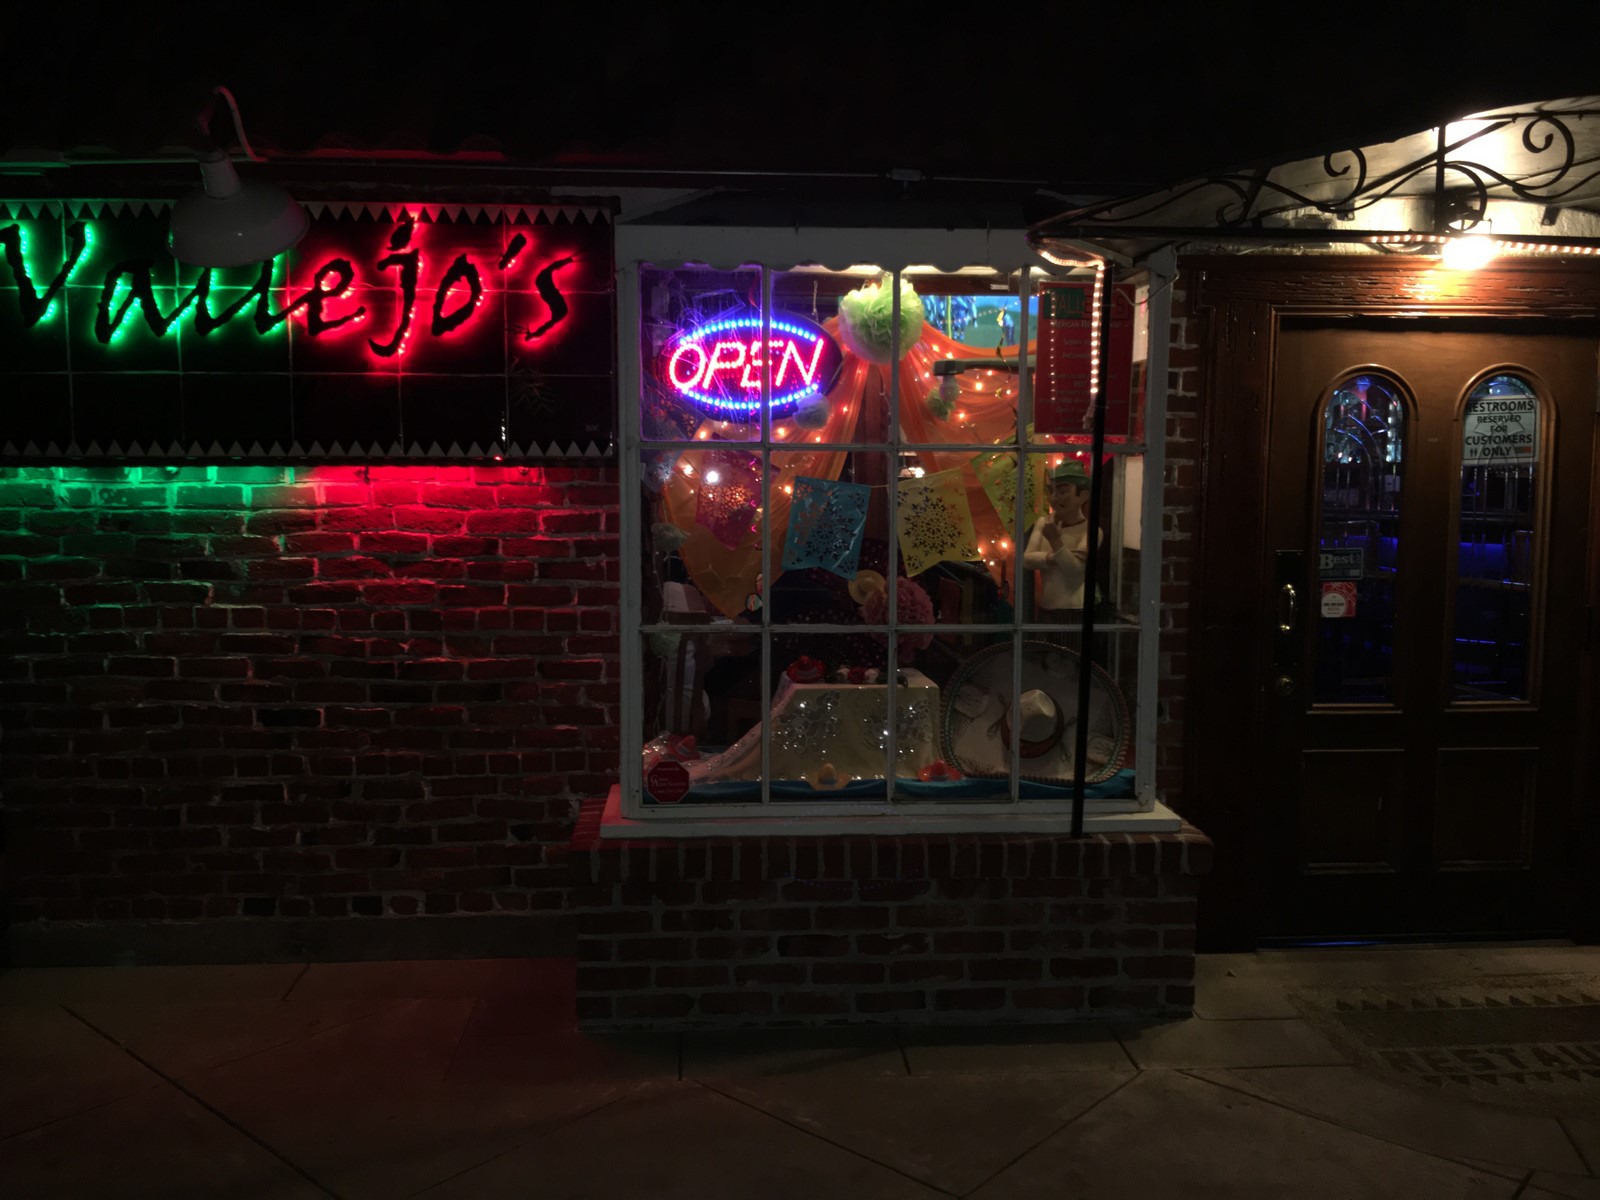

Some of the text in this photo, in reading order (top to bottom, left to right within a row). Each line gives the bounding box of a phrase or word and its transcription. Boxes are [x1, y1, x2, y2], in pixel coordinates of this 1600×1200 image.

[669, 339, 824, 390] OPEN
[1477, 415, 1522, 423] RESERVED
[1490, 425, 1508, 433] FOR
[1465, 434, 1532, 445] CUSTOMERS
[1483, 446, 1511, 457] ONLY
[1378, 1045, 1600, 1073] RESTAU
